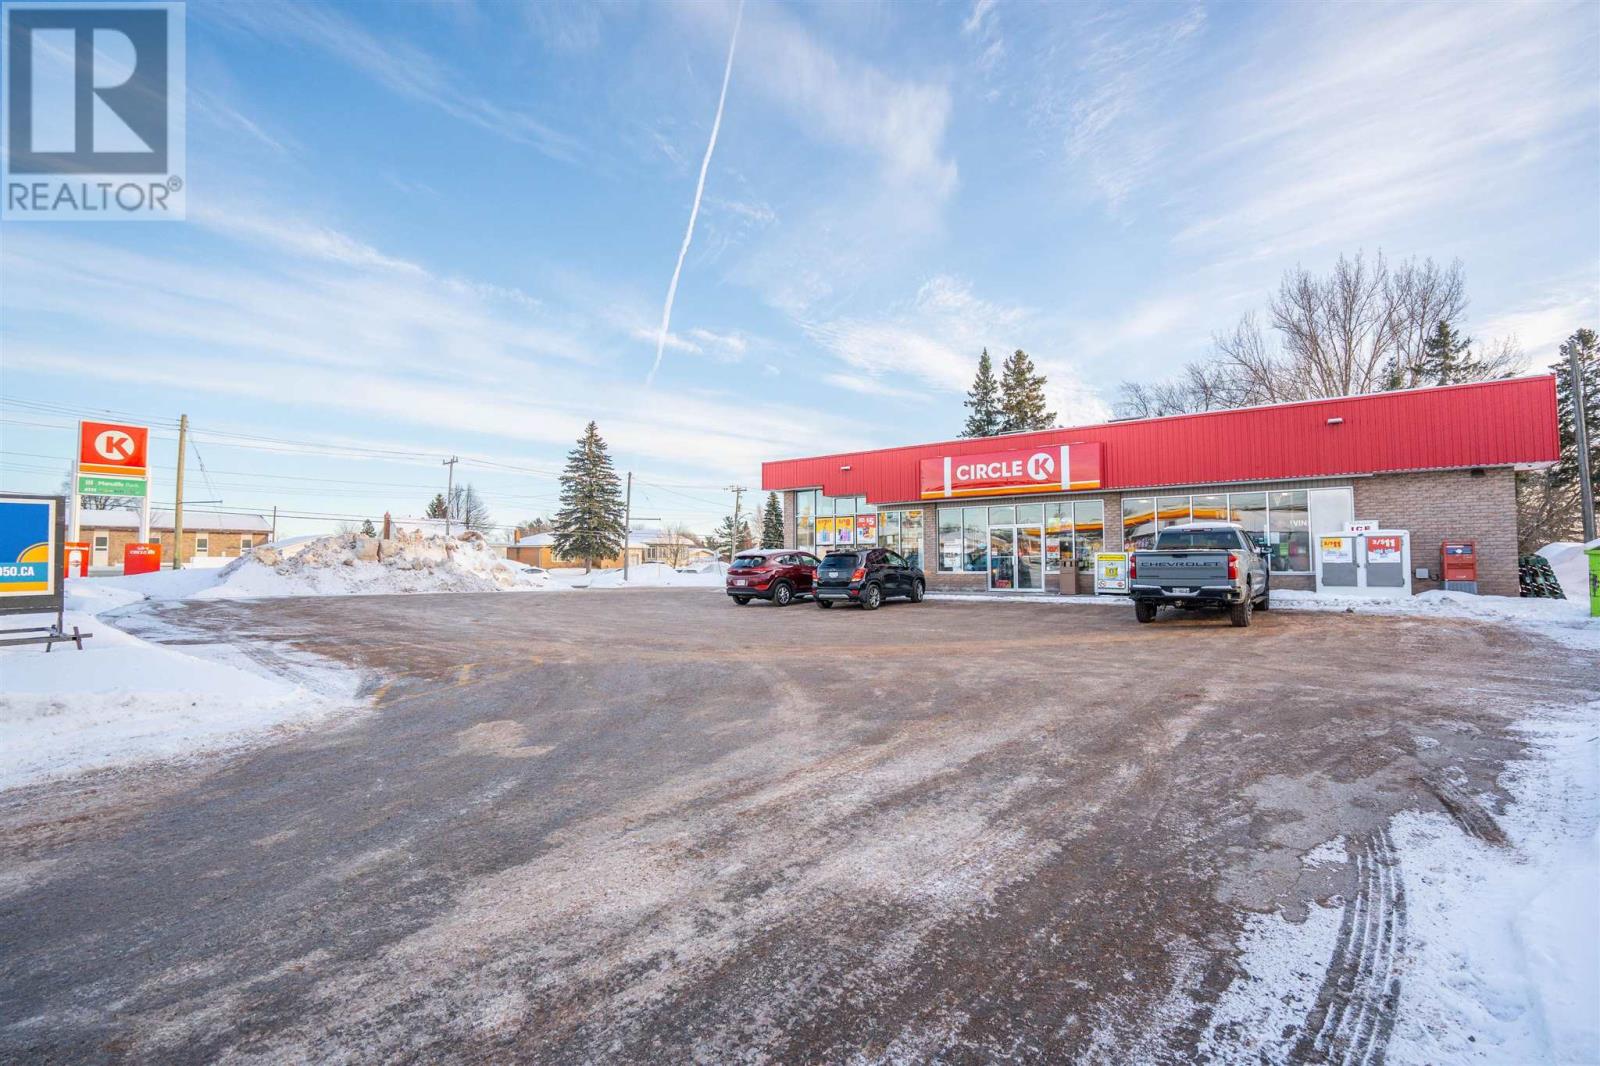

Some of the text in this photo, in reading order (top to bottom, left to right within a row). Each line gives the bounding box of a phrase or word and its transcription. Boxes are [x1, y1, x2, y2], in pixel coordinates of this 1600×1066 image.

[104, 433, 134, 459] K
[956, 455, 1054, 481] CIRCLE K
